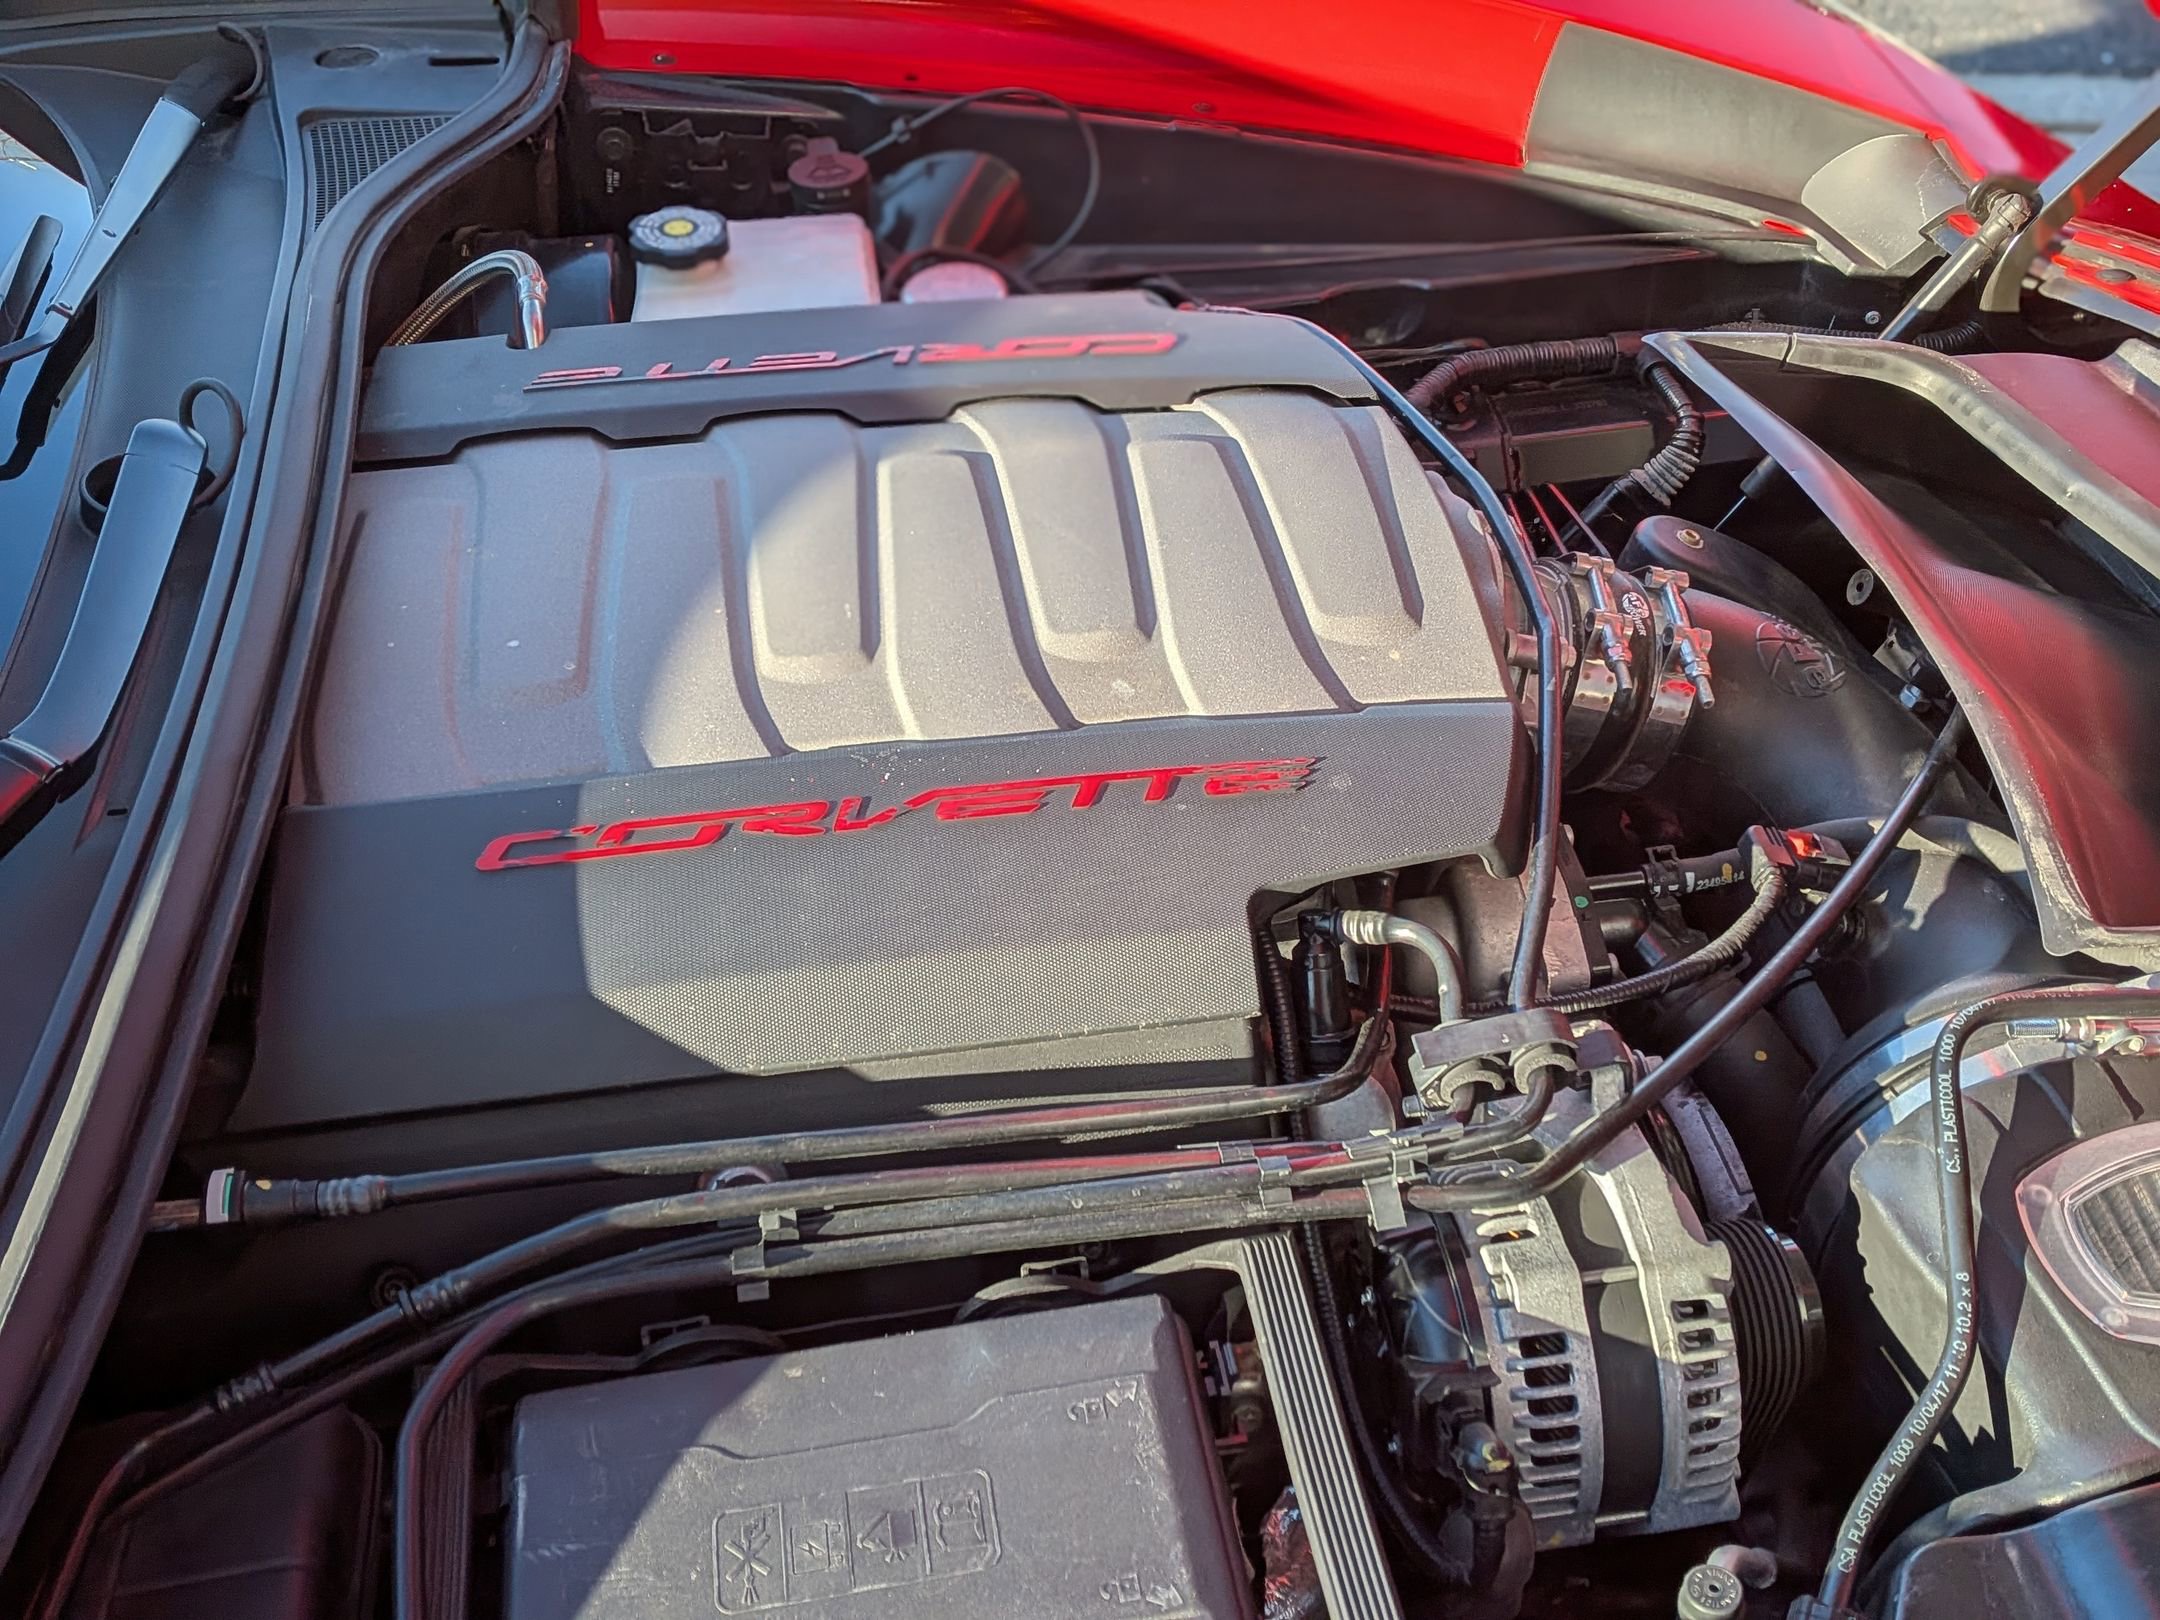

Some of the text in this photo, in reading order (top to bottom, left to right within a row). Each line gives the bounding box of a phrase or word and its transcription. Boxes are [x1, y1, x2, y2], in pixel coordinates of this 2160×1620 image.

[523, 332, 1180, 392] CORVETTE
[475, 757, 1316, 872] CORVETTE
[1940, 1034, 1957, 1063] 1000
[1939, 1068, 1958, 1143] PLASTICOOL
[1956, 1272, 1970, 1282] 8
[1961, 1288, 1972, 1298] x
[1956, 1301, 1972, 1335] 10.2
[1909, 1380, 1951, 1437] 10/04/17
[1889, 1438, 1915, 1468] 1000
[1837, 1548, 1858, 1574] CSA
